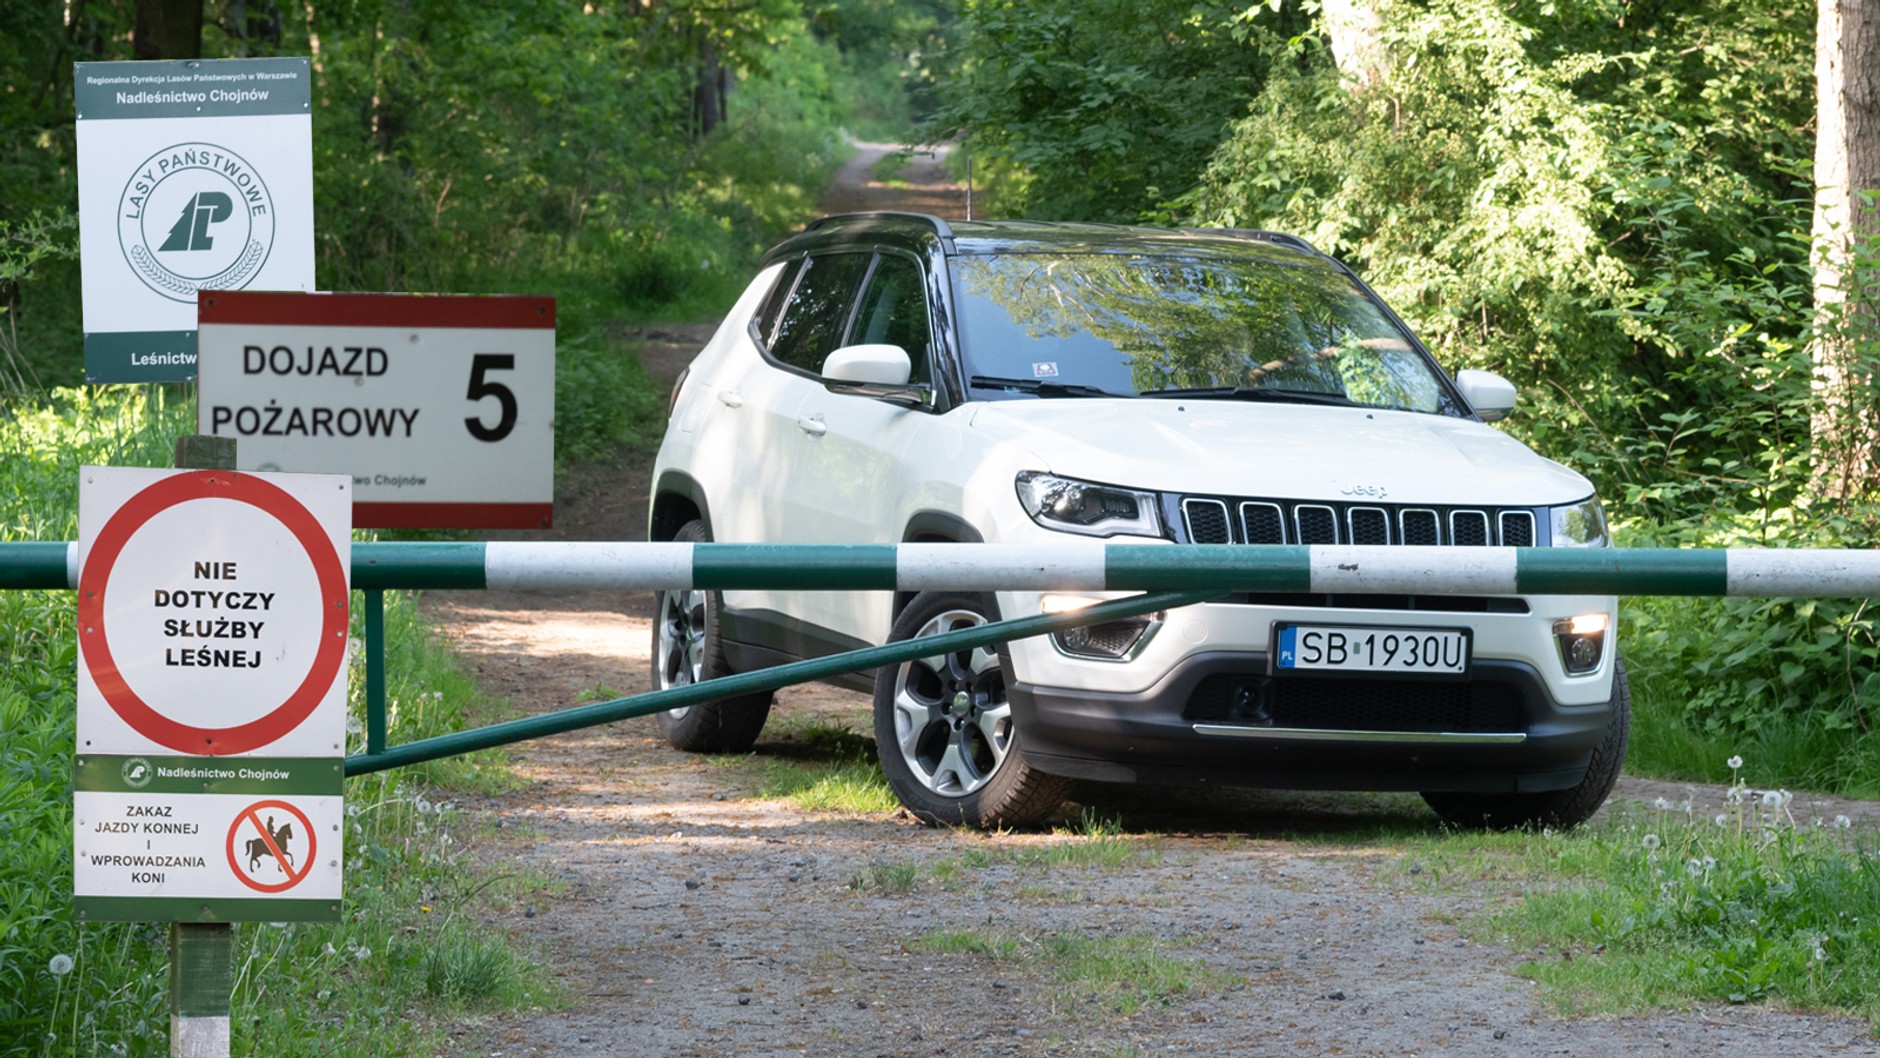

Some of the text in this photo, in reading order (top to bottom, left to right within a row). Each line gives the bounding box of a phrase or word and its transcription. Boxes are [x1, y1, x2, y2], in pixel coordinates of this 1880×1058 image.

[87, 76, 130, 85] Regionalna
[131, 75, 165, 84] Dyrekcja
[193, 73, 247, 82] Państwowych
[256, 72, 297, 80] Warszawie
[116, 88, 269, 104] Nadleśnictwo Chojnów
[126, 148, 266, 219] LASY PAŃSTWOWE
[131, 352, 198, 366] Leśnictw
[243, 345, 389, 377] DOJAZD
[464, 353, 518, 443] 5
[211, 399, 420, 438] POŻAROWY
[374, 474, 427, 488] Chojnów
[1341, 480, 1388, 499] Jeep
[194, 561, 237, 580] NIE
[154, 589, 276, 610] DOTYCZY
[164, 616, 265, 639] SŁUŻBY
[166, 645, 261, 668] LEŚNEJ
[1282, 651, 1293, 661] PL
[1302, 632, 1462, 668] SB 1930U
[157, 767, 290, 781] Nadleśnictwo Chojnów
[126, 806, 172, 817] ZAKAZ
[95, 822, 199, 834] JAZDY KONNEJ
[147, 839, 151, 850] I
[91, 855, 206, 867] WPROWADZANIA
[131, 872, 165, 883] KONI
